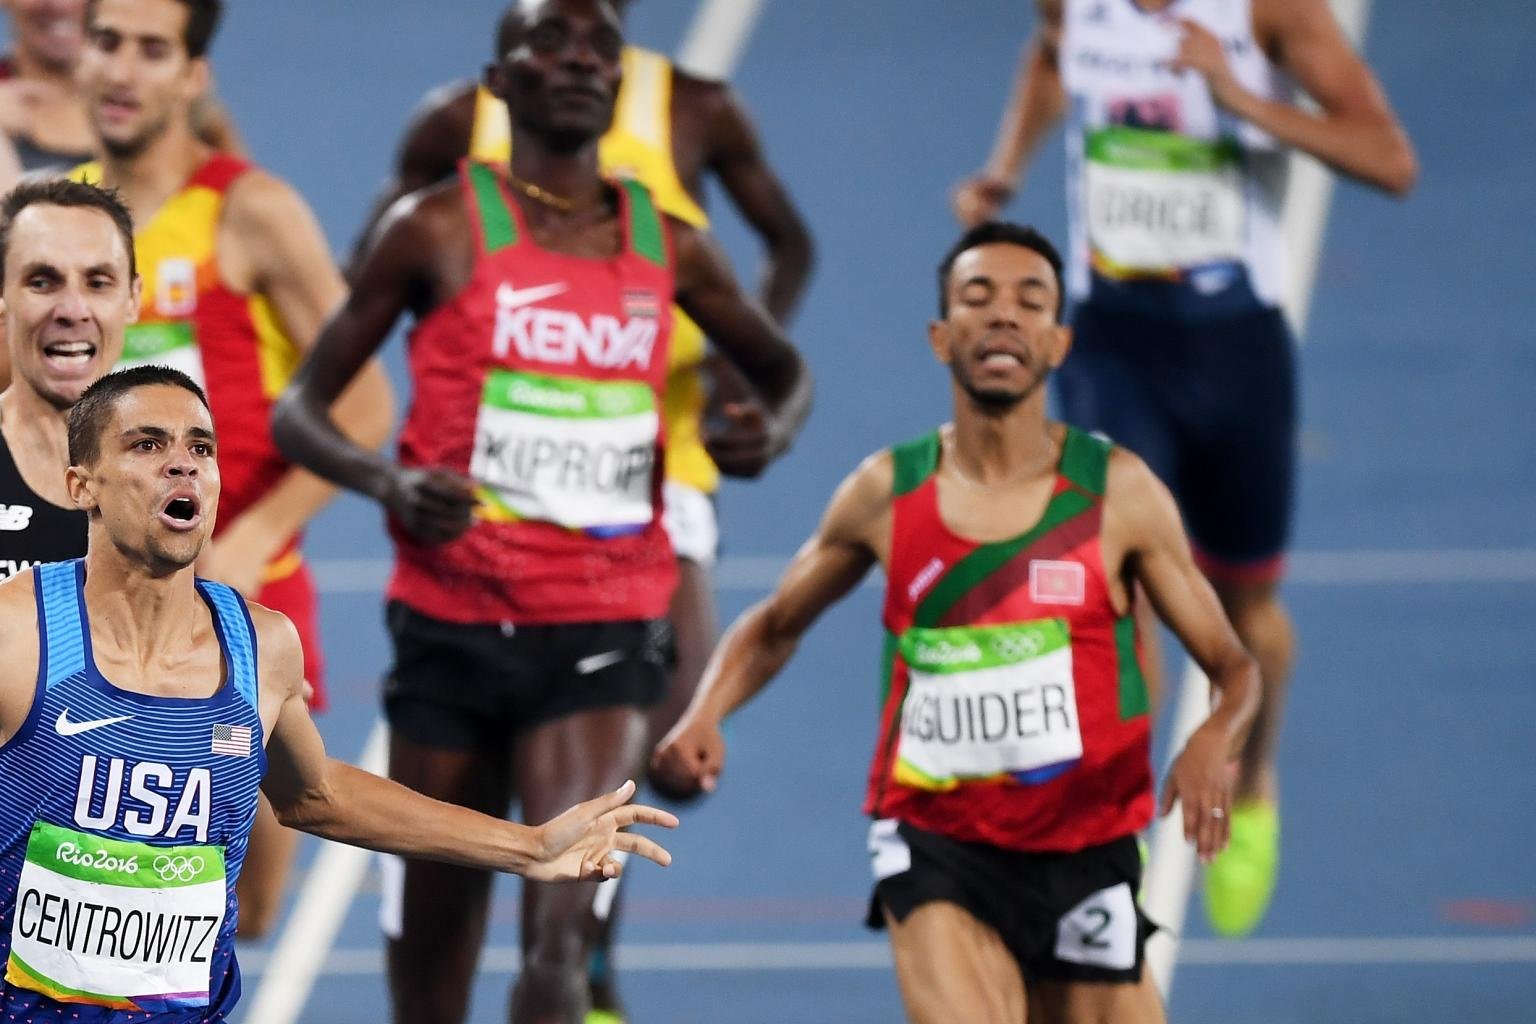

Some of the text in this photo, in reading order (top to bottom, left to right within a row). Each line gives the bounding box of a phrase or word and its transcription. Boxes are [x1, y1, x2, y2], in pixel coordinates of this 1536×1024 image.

[491, 305, 658, 371] KENYA
[480, 432, 655, 492] KIPROP
[73, 754, 211, 843] USA
[56, 841, 139, 874] Rio2016
[18, 888, 218, 964] CENTROWITZ
[1080, 906, 1111, 950] 2
